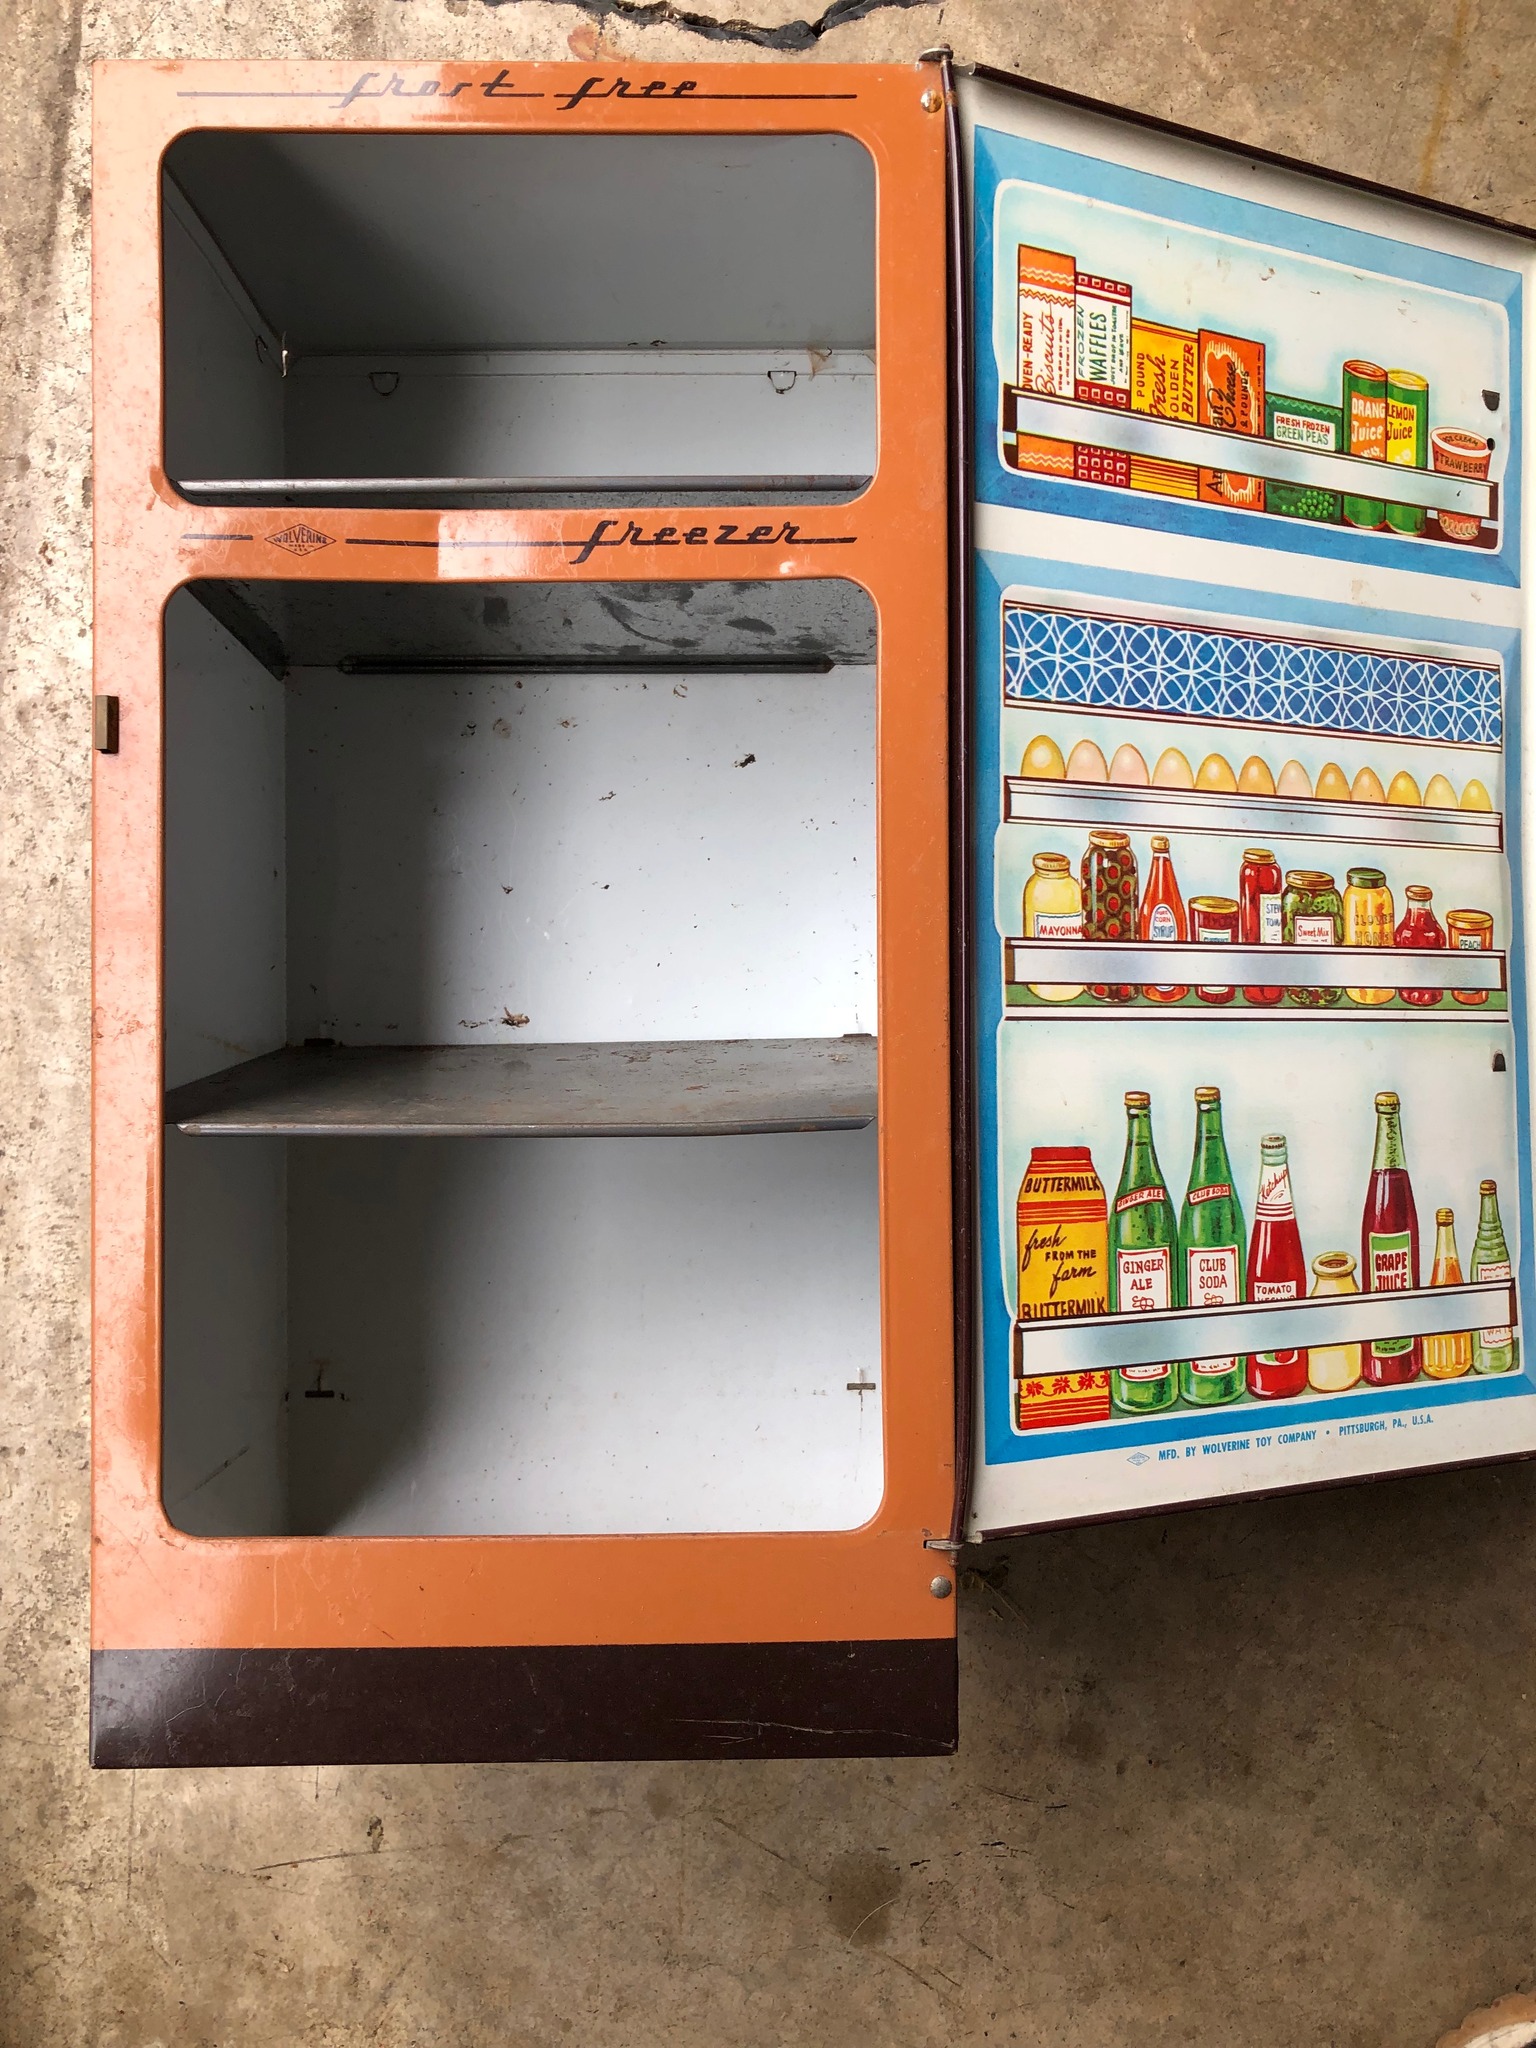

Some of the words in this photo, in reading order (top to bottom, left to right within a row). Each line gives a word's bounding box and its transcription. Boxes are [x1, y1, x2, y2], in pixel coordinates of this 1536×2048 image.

[328, 69, 518, 109] frost
[556, 77, 698, 111] free
[1035, 303, 1056, 395] Biscuits
[1077, 304, 1085, 379] FROZEN
[1088, 311, 1107, 381] WAFFLES
[1136, 352, 1145, 397] POUND
[1181, 343, 1194, 418] BUTTER
[1387, 402, 1415, 421] LEMON
[1275, 415, 1301, 428] FRESH
[1302, 419, 1330, 434] FROZEN
[1351, 420, 1384, 443] Juice
[1387, 421, 1413, 441] Juice
[1276, 425, 1304, 441] GREEN
[1305, 430, 1329, 446] PEAS
[273, 526, 327, 544] WOLVERINE
[569, 520, 801, 565] freezer
[1297, 924, 1316, 938] Sweet
[1317, 926, 1329, 937] Mix
[1024, 1176, 1101, 1194] BUTTERMILK
[1147, 1188, 1162, 1198] ALE
[1192, 1188, 1211, 1201] CLUB
[1021, 1224, 1067, 1272] fresh
[1045, 1250, 1074, 1262] FROM
[1077, 1249, 1097, 1260] THE
[1122, 1258, 1165, 1275] GINGER
[1199, 1257, 1227, 1272] CLUB
[1375, 1251, 1408, 1272] GRAPE
[1049, 1261, 1097, 1299] farm
[1130, 1278, 1153, 1291] ALE
[1199, 1274, 1228, 1289] SODA
[1256, 1284, 1292, 1295] TOMATO
[1375, 1272, 1408, 1291] JUICE
[1158, 1449, 1180, 1461] MFD.
[1185, 1446, 1197, 1457] BY
[1202, 1439, 1250, 1455] WOLVERINE
[1255, 1436, 1272, 1448] TOY
[1277, 1430, 1317, 1445] COMPANY
[1339, 1420, 1388, 1436] PITTSBURGH,
[1412, 1413, 1434, 1426] U.S.A.
